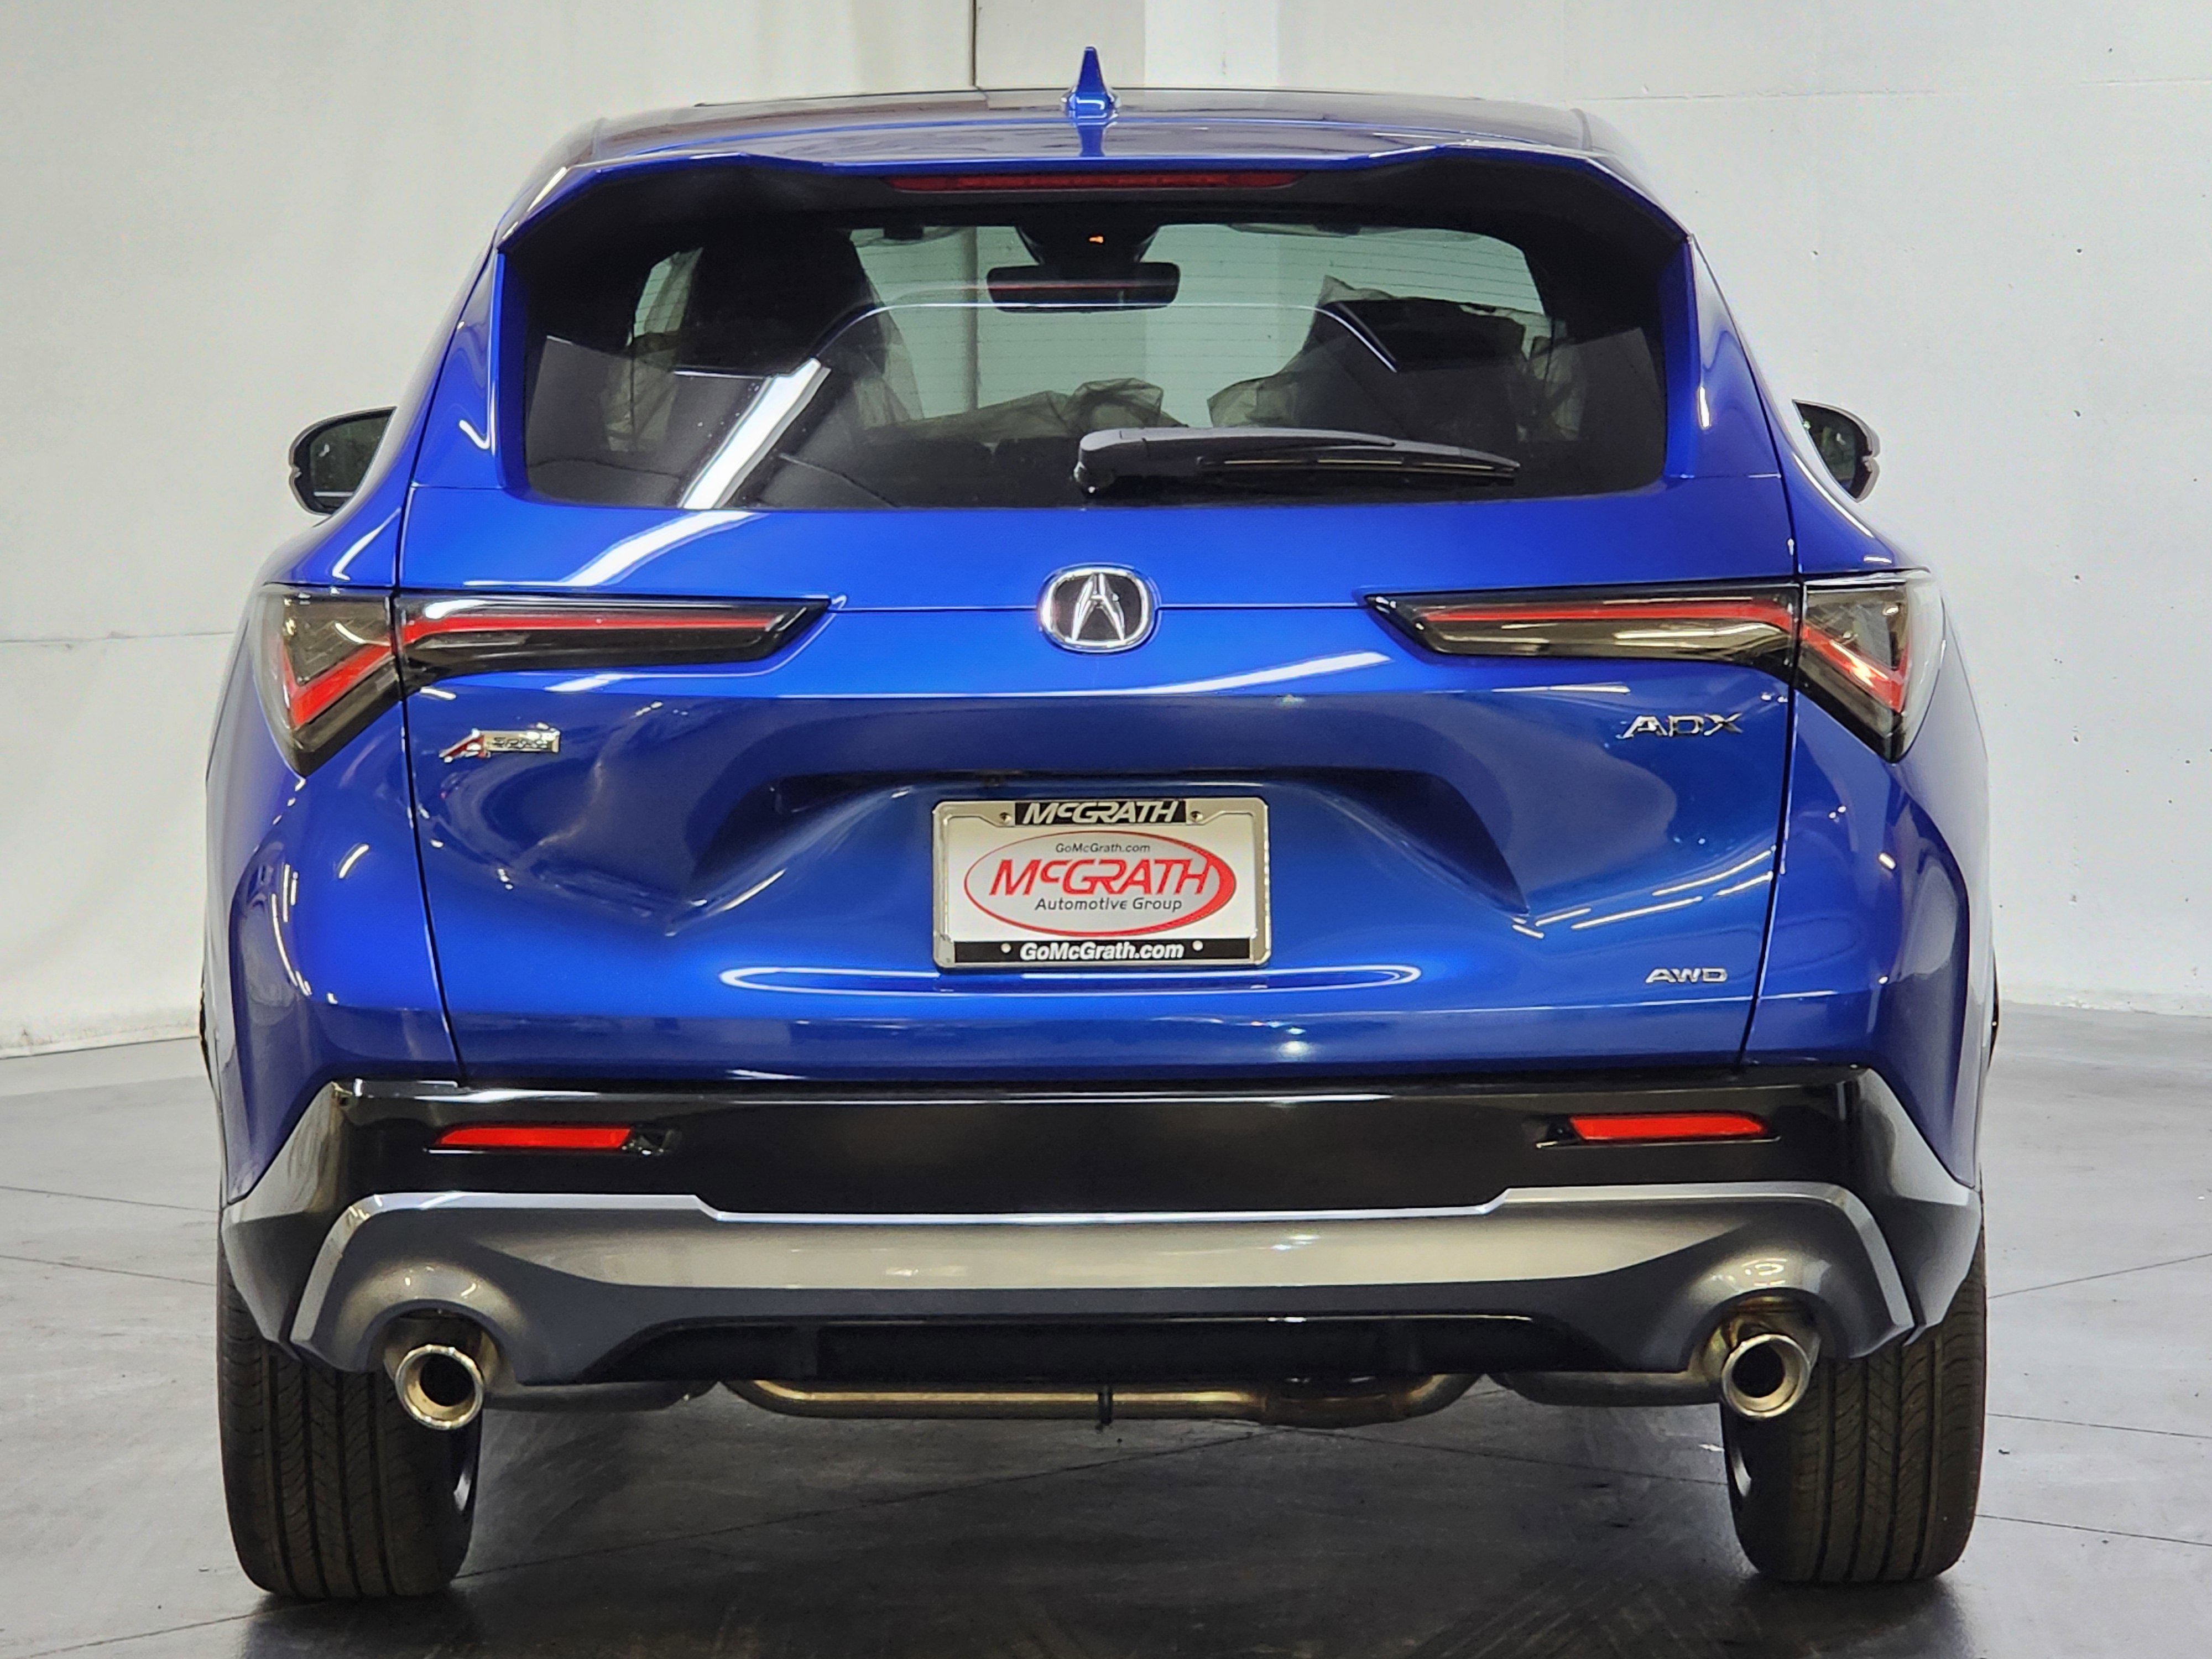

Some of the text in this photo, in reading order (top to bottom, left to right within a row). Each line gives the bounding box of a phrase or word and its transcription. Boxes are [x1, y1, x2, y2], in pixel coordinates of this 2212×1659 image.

[1616, 713, 1743, 739] ADX
[1055, 843, 1151, 854] GoMcGrath.com
[1034, 898, 1183, 913] Automotive Group
[1019, 941, 1185, 961] GoMcGrath.com
[1645, 968, 1728, 983] AWD
